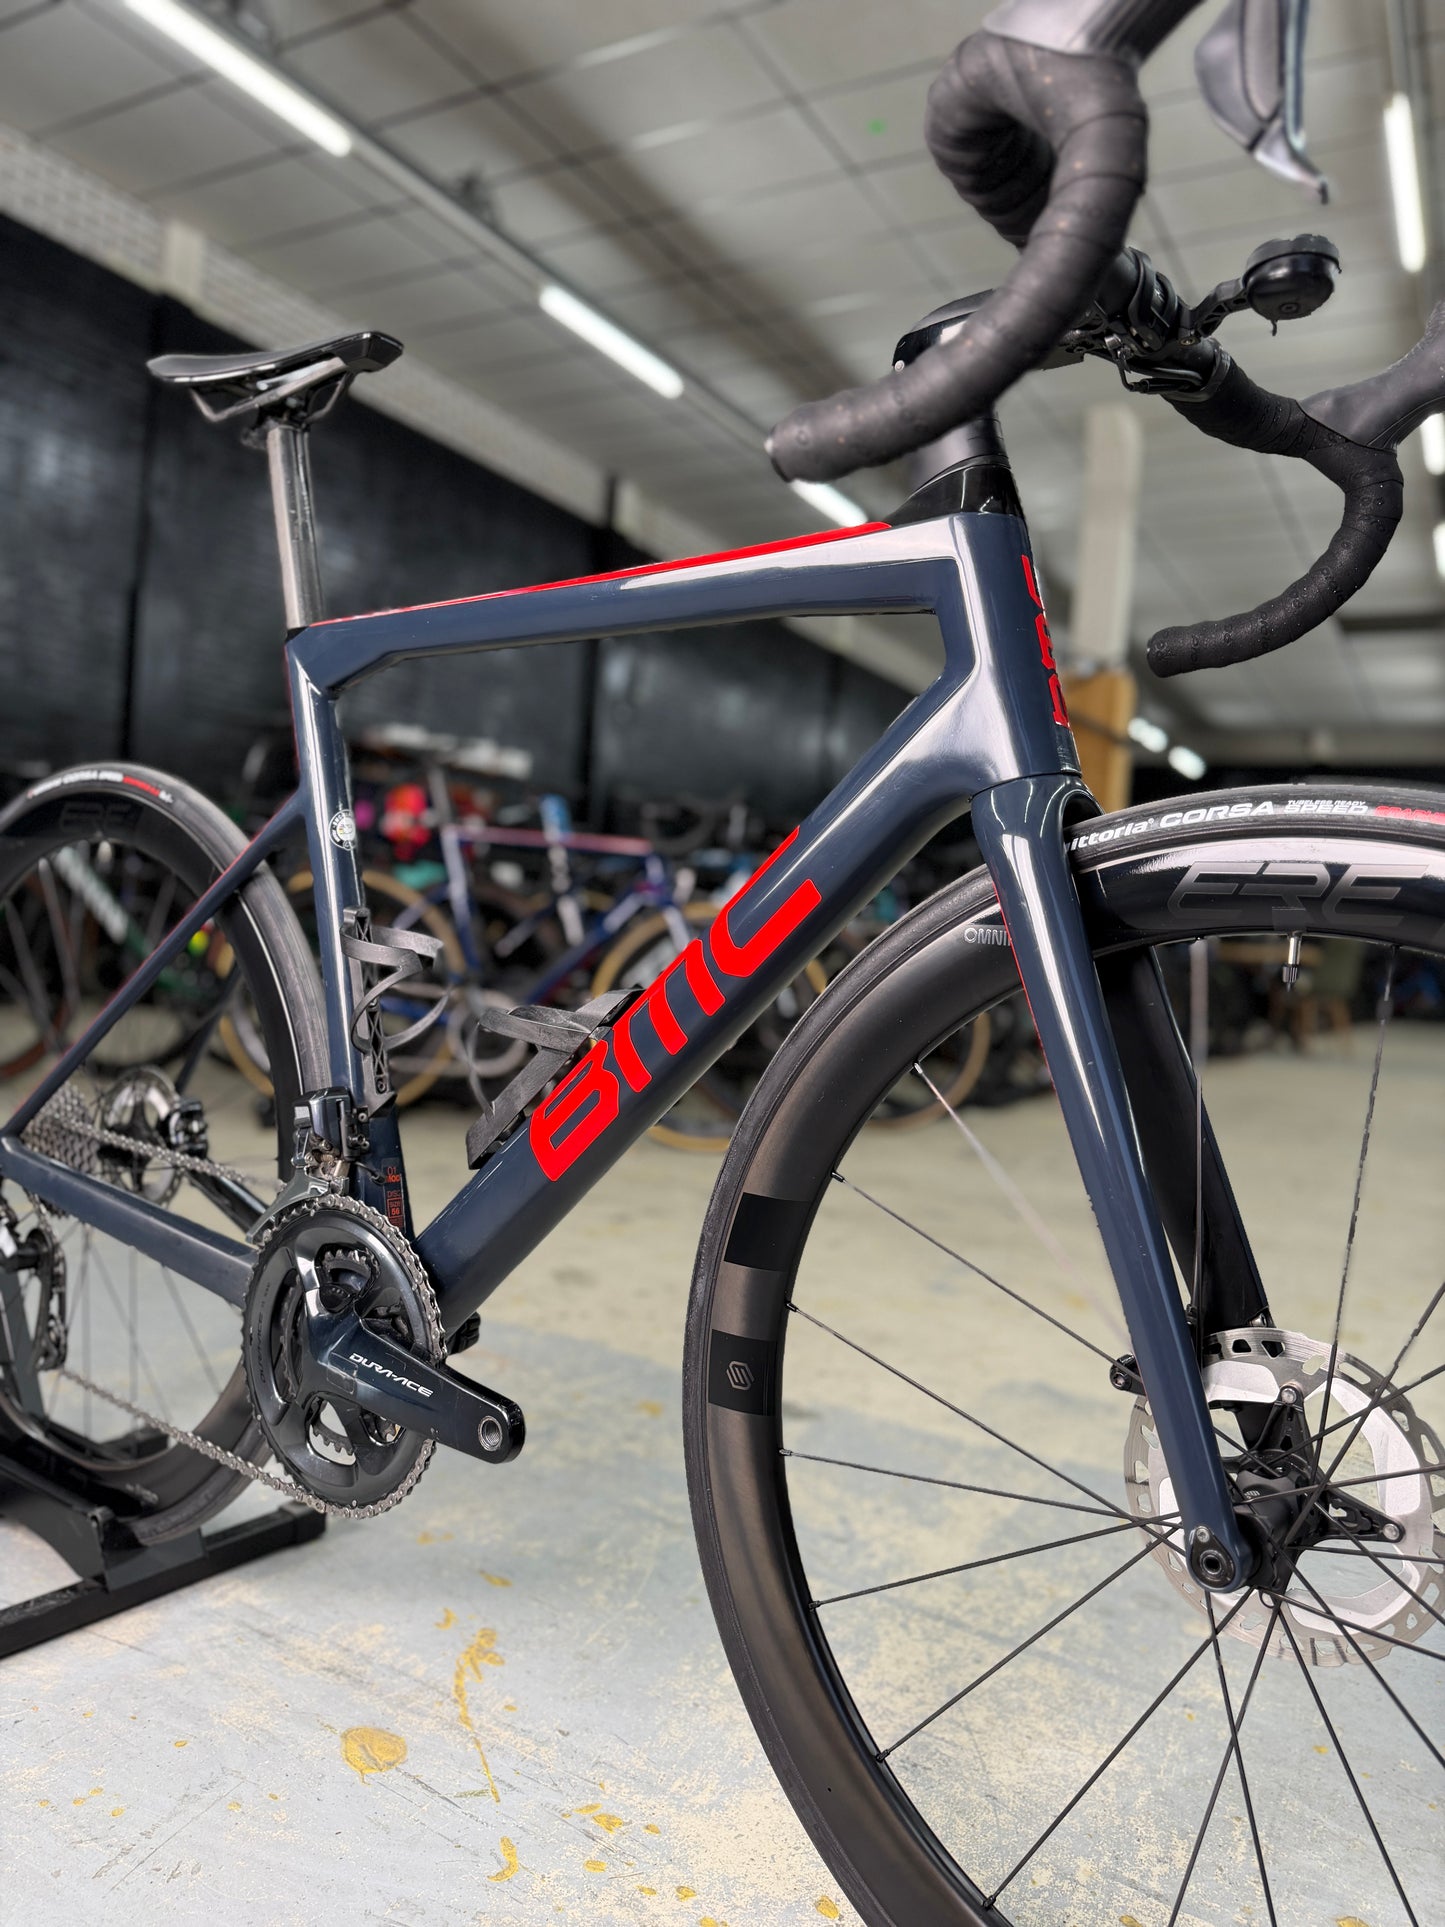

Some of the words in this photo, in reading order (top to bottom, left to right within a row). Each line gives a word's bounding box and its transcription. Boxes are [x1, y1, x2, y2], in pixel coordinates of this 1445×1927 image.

[1159, 801, 1275, 829] CORSA
[1284, 804, 1369, 815] SPEED
[349, 1351, 434, 1398] DURA-ACE
